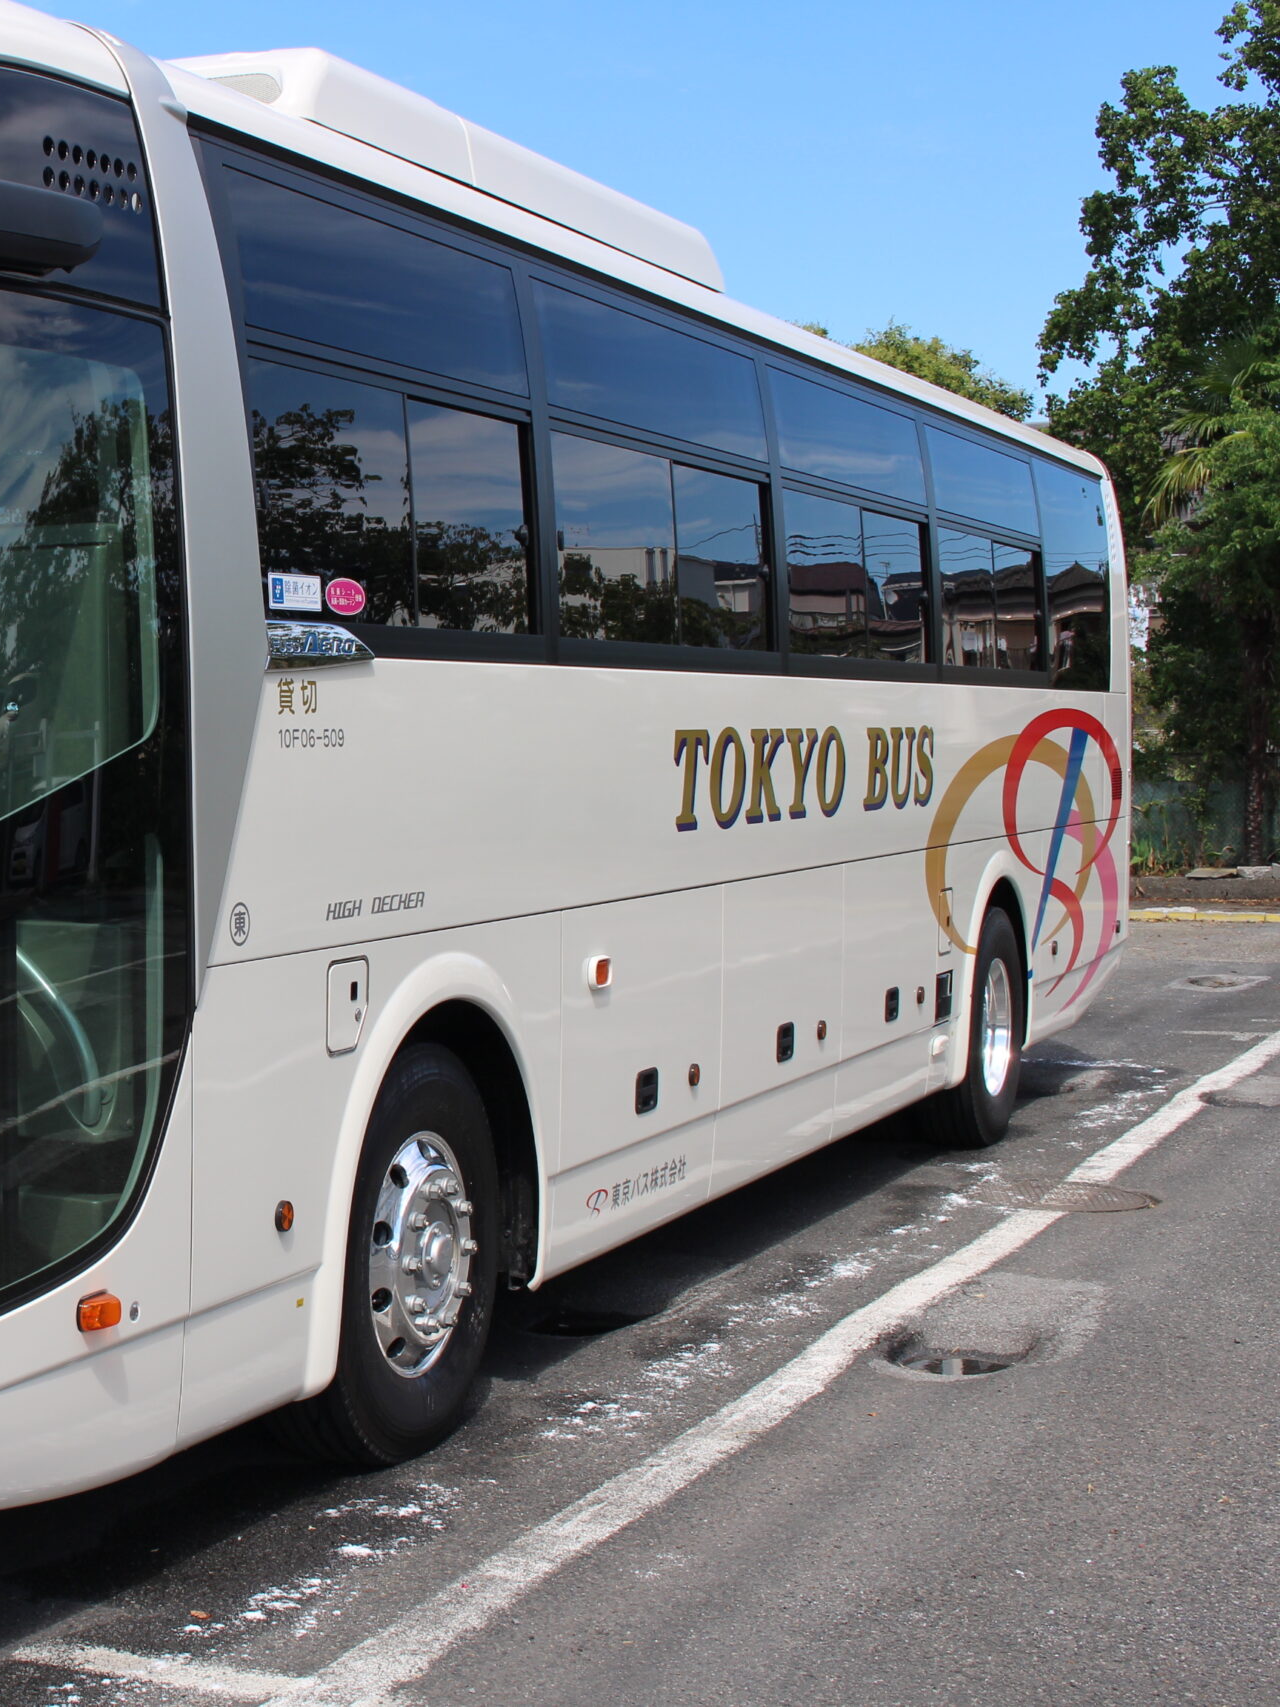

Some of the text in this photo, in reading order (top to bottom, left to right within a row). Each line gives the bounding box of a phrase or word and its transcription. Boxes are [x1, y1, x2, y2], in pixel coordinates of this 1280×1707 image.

[303, 631, 356, 655] AERO
[277, 678, 318, 715] 貸切
[277, 728, 345, 749] 10F06-509
[673, 725, 934, 832] TOKYO BUS
[326, 891, 425, 921] HIGH DECKER
[610, 1154, 687, 1212] 東京バス株式会社
